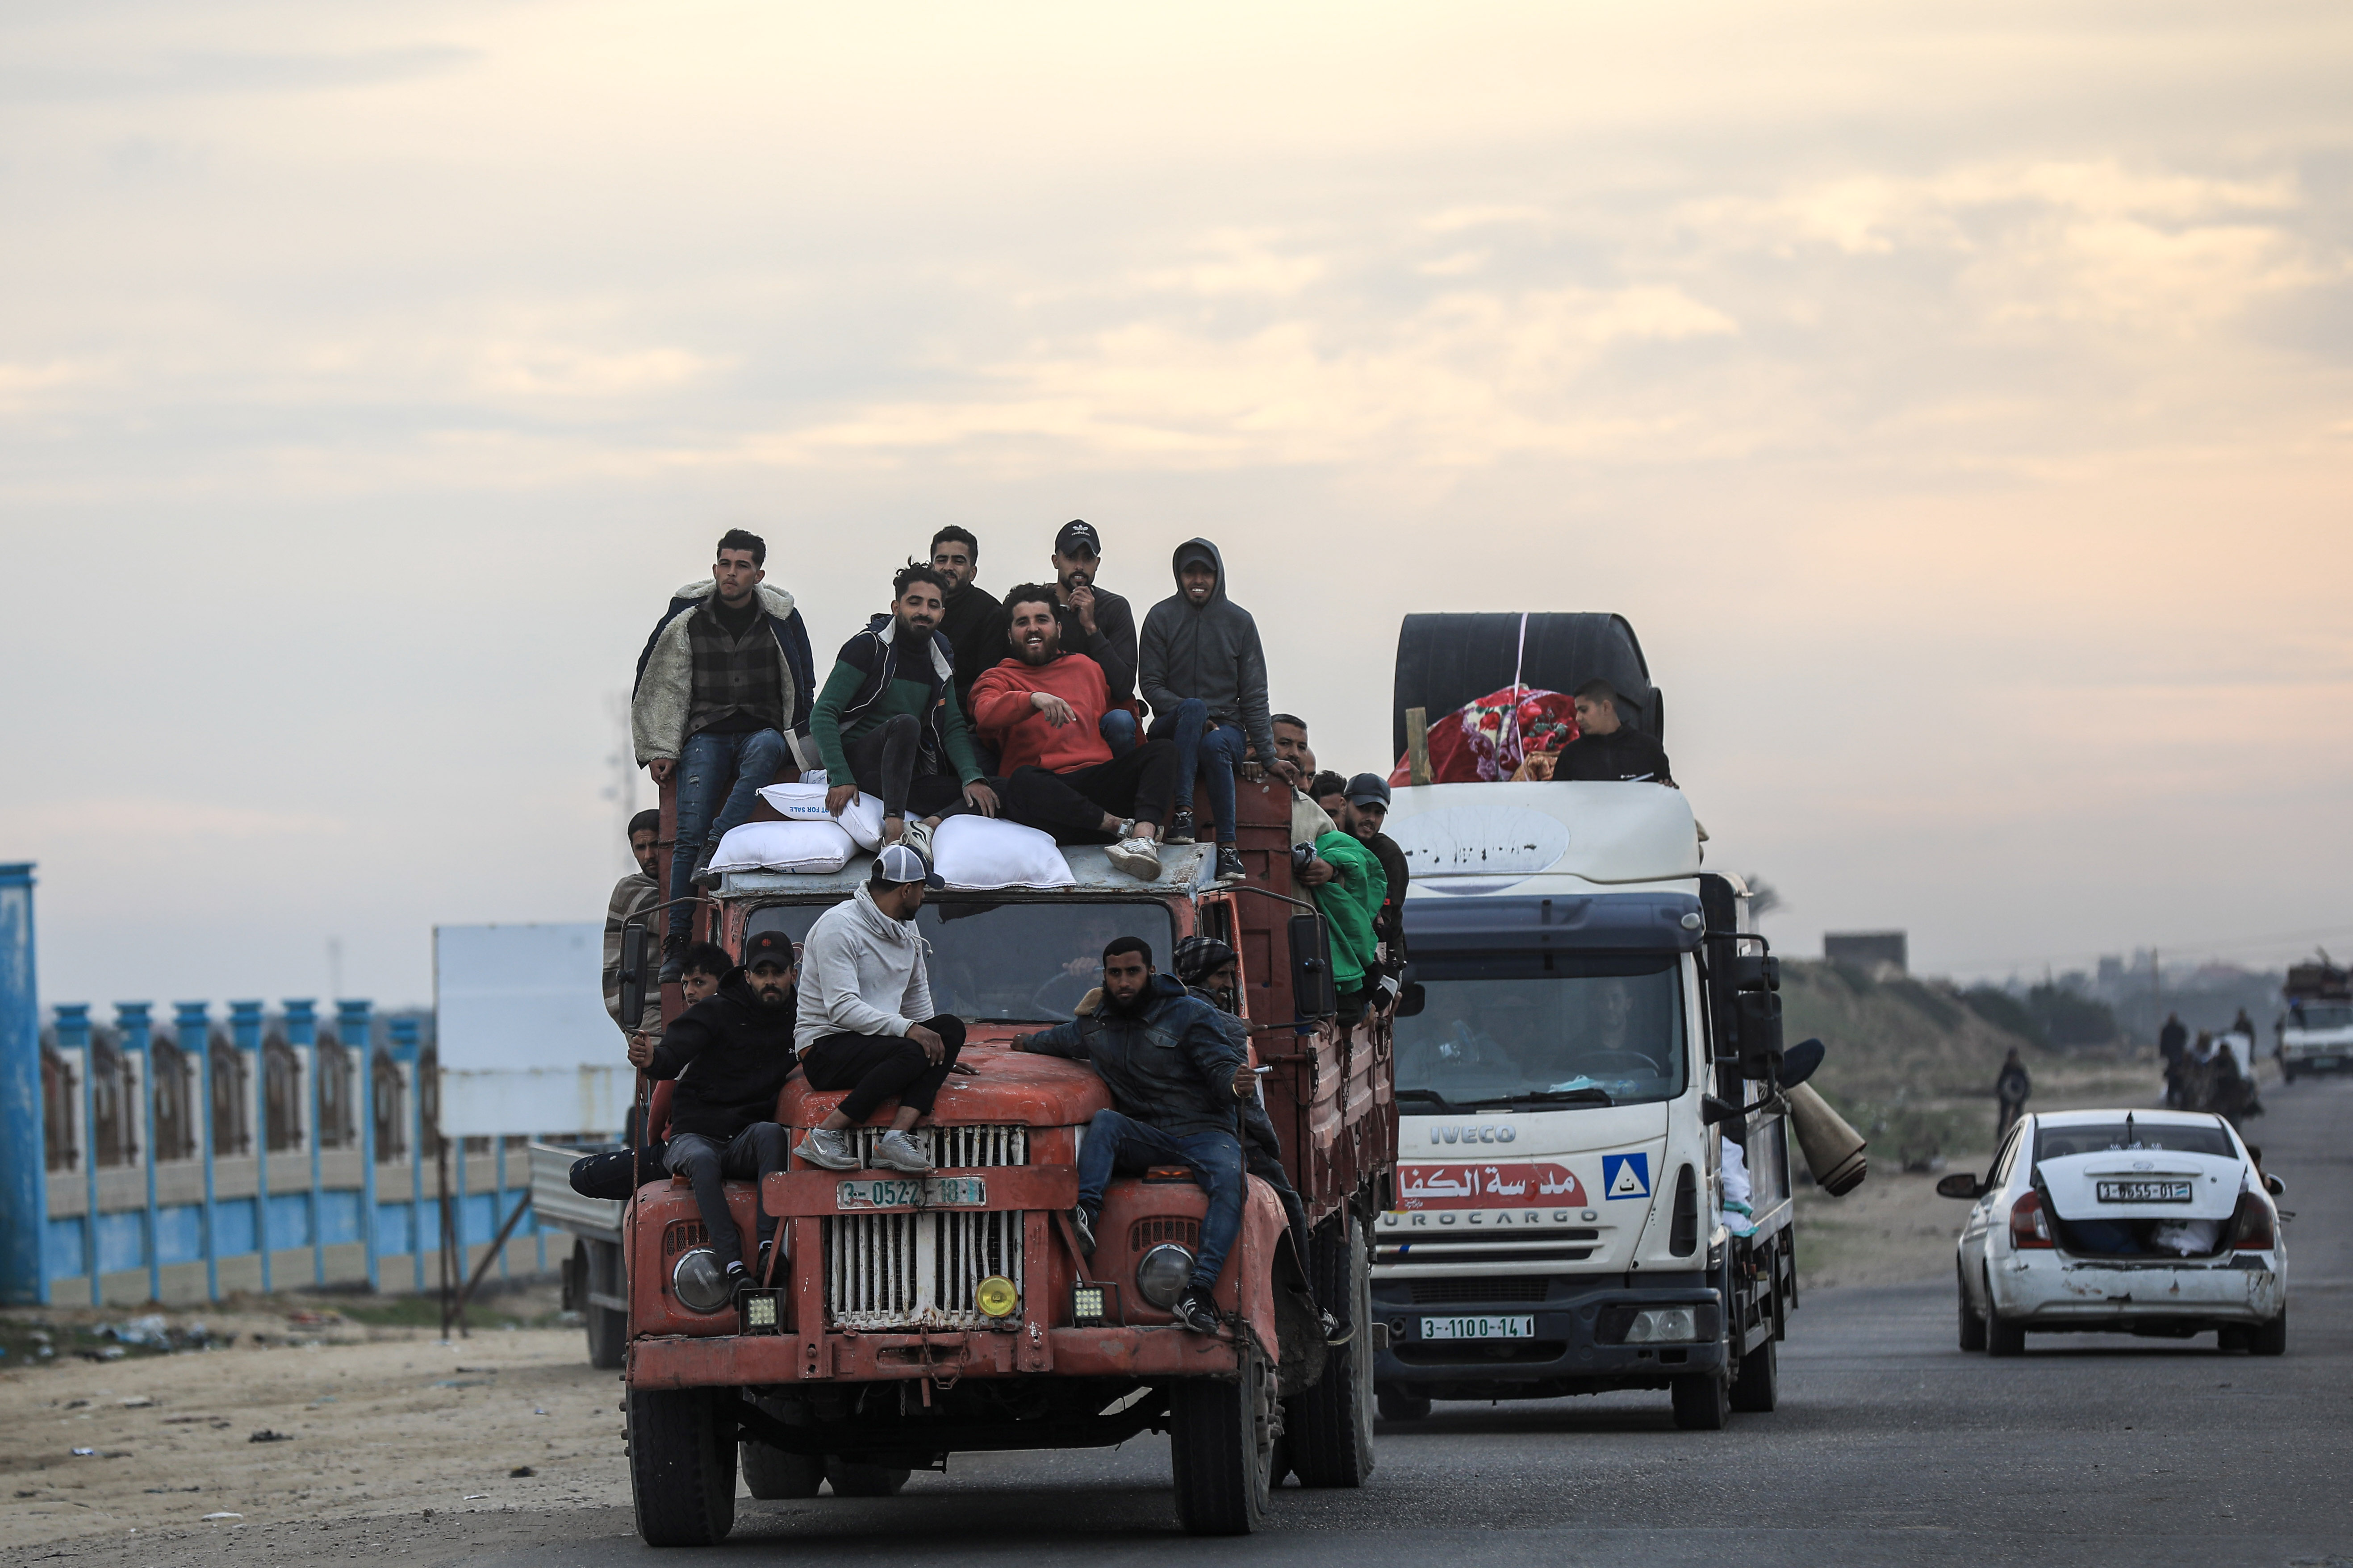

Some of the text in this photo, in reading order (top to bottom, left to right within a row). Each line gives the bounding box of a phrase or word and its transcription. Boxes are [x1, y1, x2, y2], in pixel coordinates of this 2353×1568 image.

[1431, 1125, 1516, 1144] IVECO
[1384, 1210, 1598, 1226] UROCARGO
[1425, 1318, 1517, 1338] 3-1100-14
